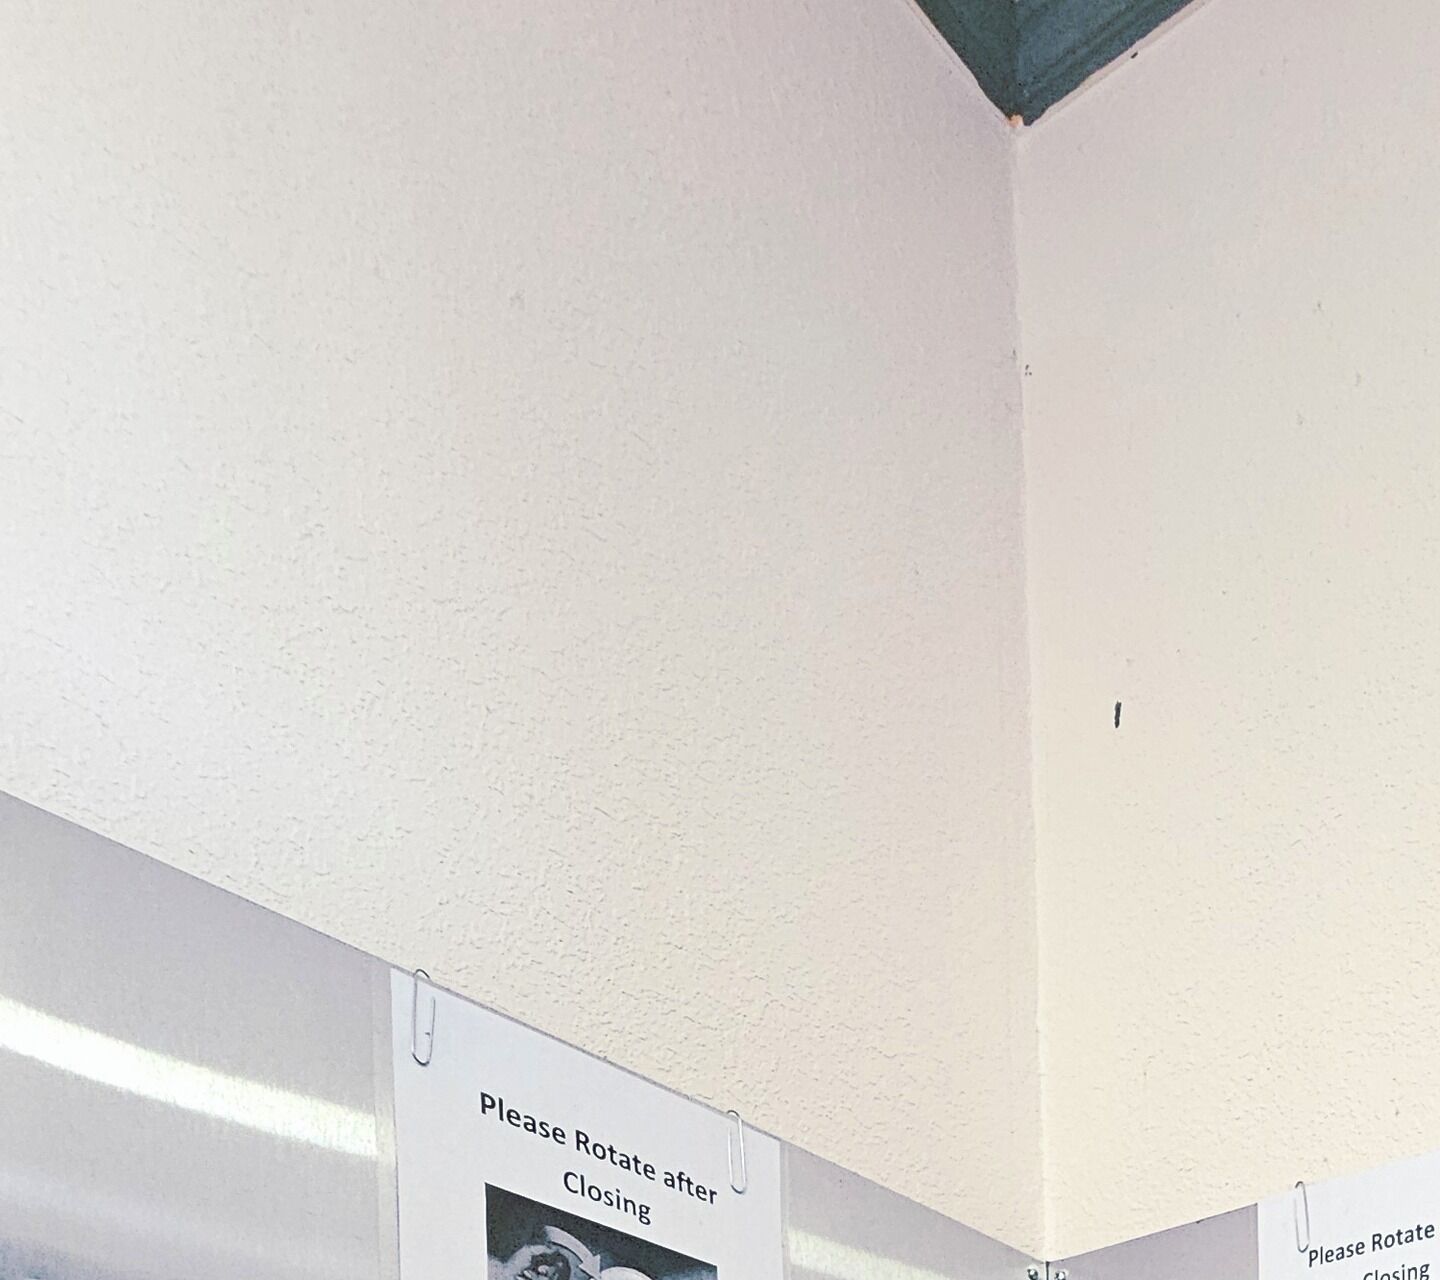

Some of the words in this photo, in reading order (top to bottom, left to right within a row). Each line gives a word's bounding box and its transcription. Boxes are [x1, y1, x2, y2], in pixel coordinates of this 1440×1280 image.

[480, 1092, 566, 1145] Please
[575, 1130, 656, 1181] Rotate
[664, 1171, 717, 1205] after
[563, 1171, 651, 1226] Closing
[1308, 1241, 1365, 1268] Please
[1372, 1223, 1435, 1252] Rotate
